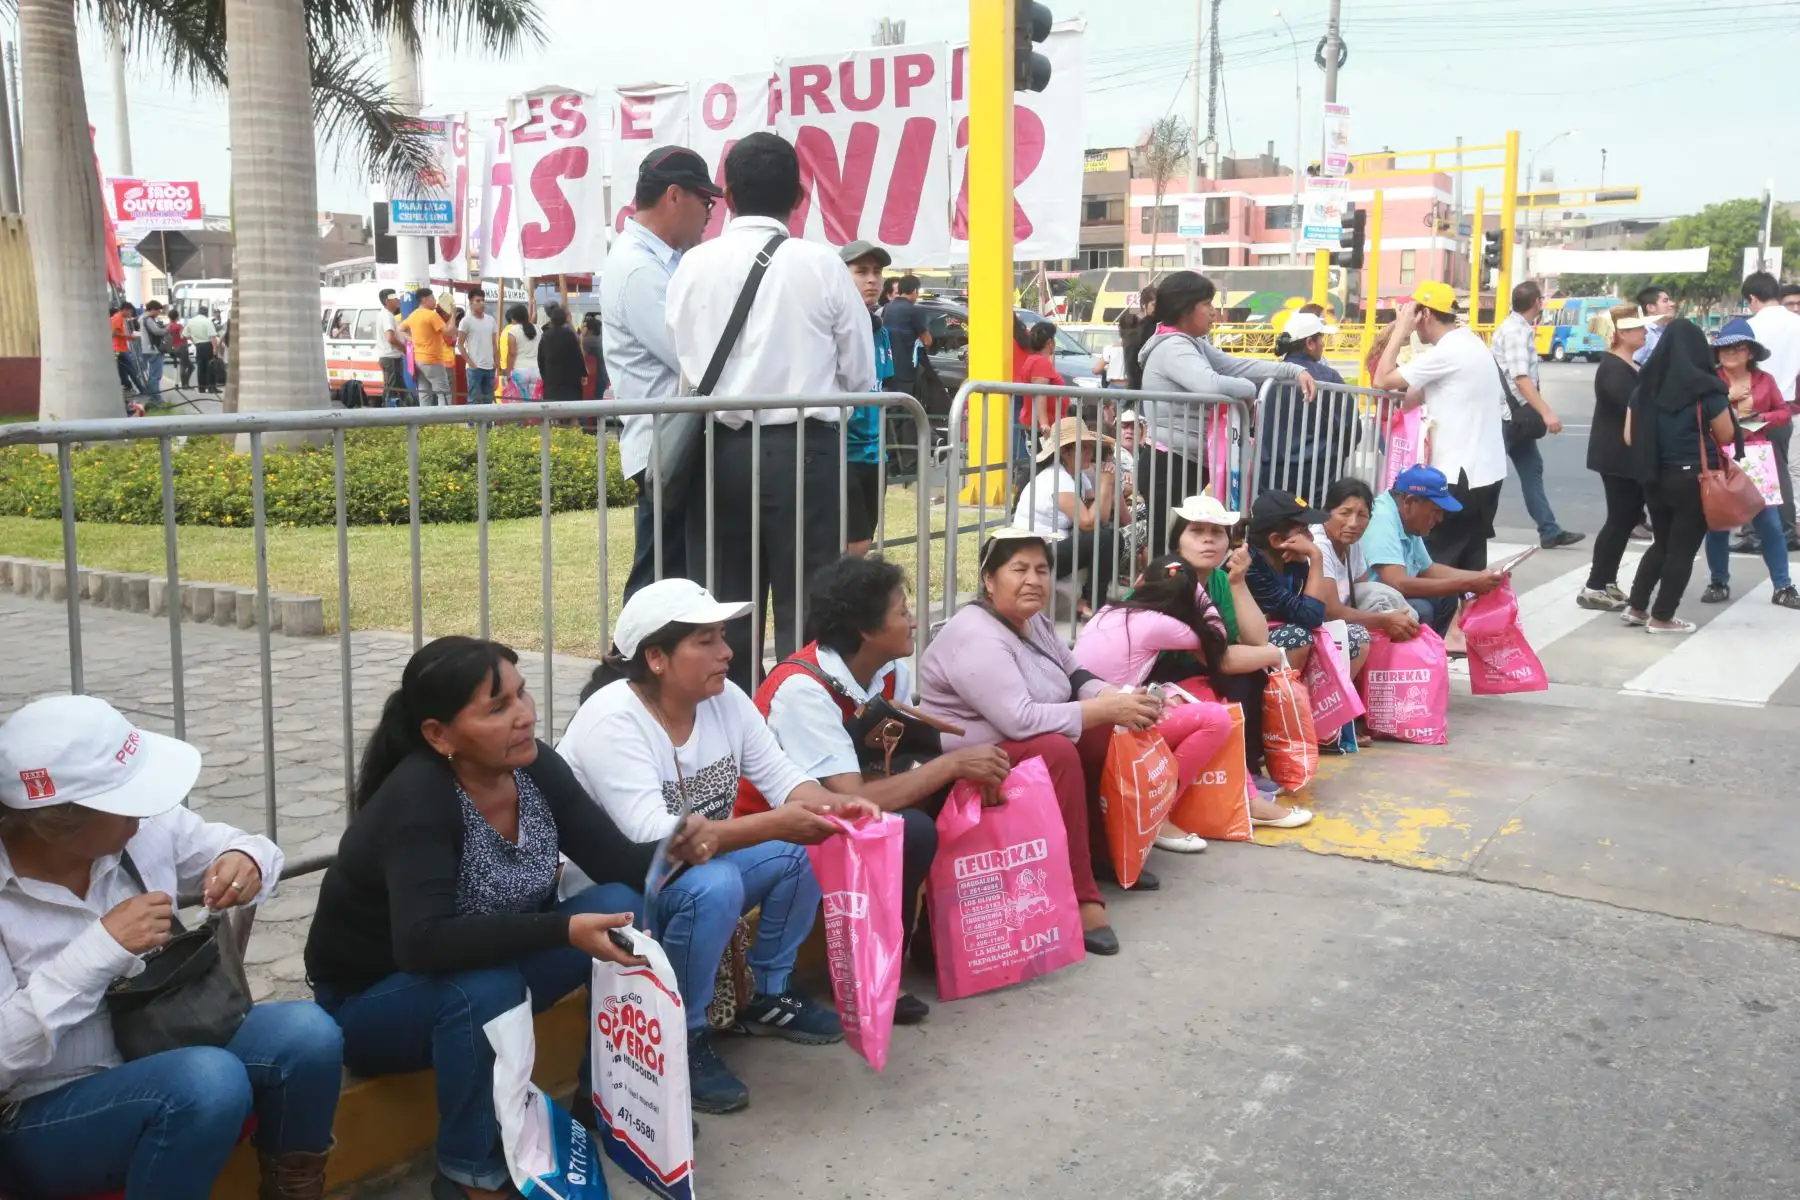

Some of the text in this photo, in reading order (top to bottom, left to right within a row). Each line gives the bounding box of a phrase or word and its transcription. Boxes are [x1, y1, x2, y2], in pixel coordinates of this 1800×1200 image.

[1317, 691, 1341, 711] UNI
[1404, 727, 1434, 739] UNI
[1021, 926, 1060, 953] UNI
[617, 1106, 656, 1143] 471-5580
